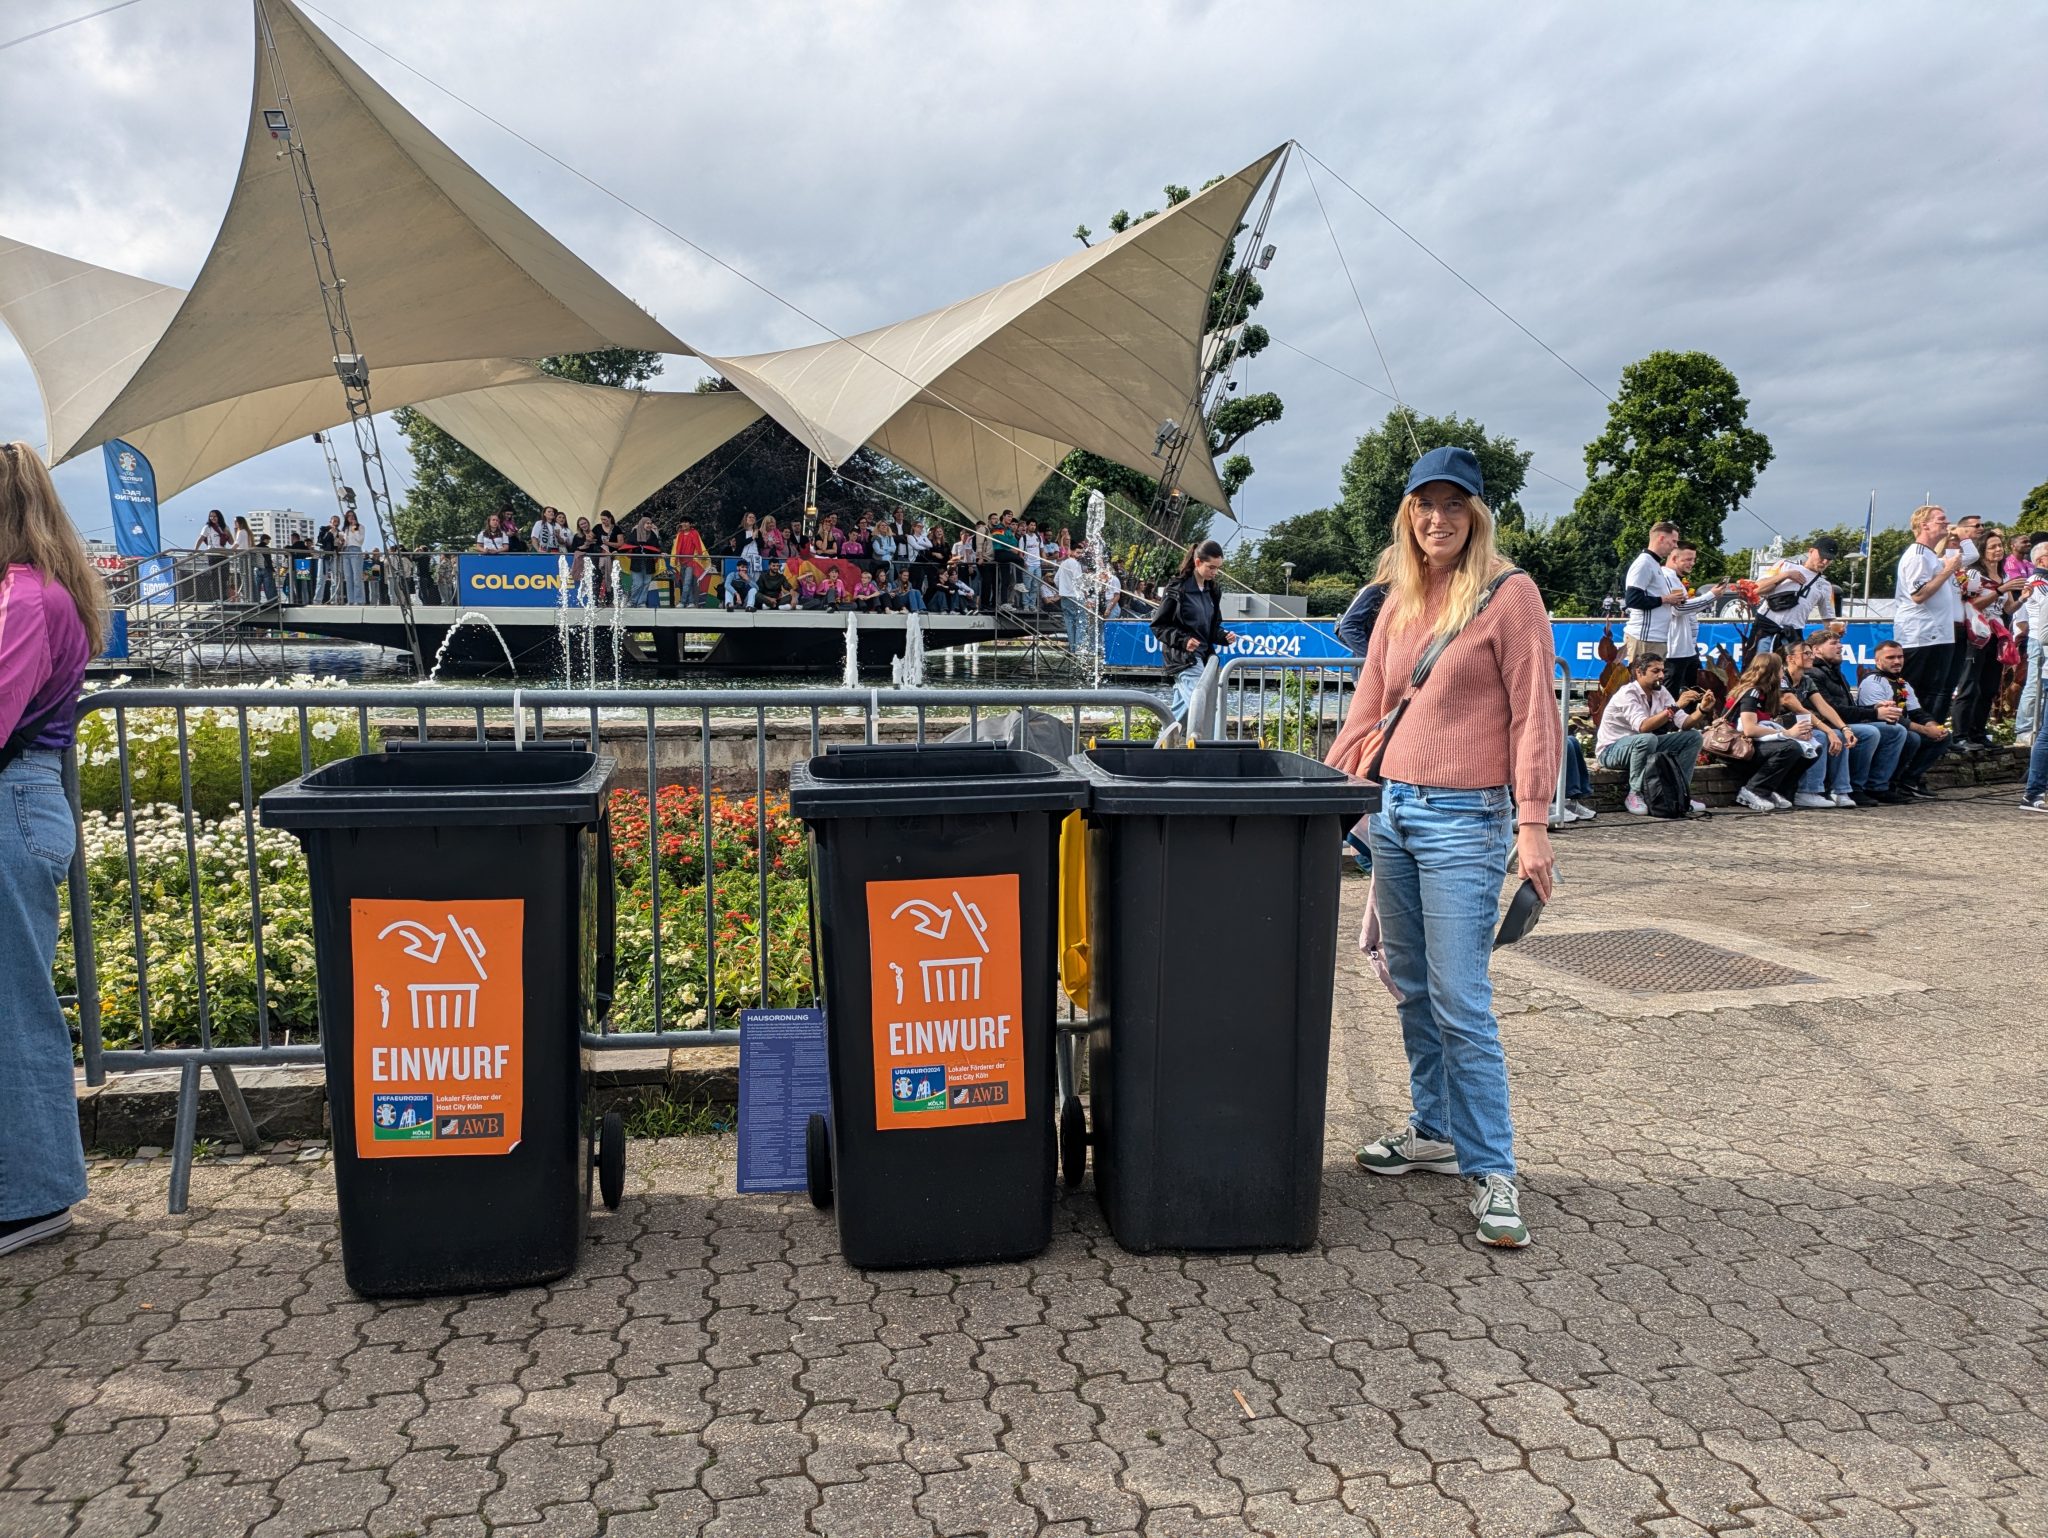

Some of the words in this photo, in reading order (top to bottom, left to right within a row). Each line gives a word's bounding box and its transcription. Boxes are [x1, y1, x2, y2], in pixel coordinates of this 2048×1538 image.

[747, 1014, 809, 1022] HAUSORDNUNG
[889, 1014, 1011, 1056] EINWURF
[372, 1045, 510, 1081] EINWURF
[970, 1064, 995, 1072] Förderer
[963, 1073, 974, 1082] City
[975, 1072, 989, 1080] Köln
[462, 1094, 489, 1102] Förderer
[490, 1093, 501, 1101] der
[972, 1085, 1004, 1104] AWB
[453, 1103, 465, 1112] City
[461, 1117, 499, 1135] AWB
